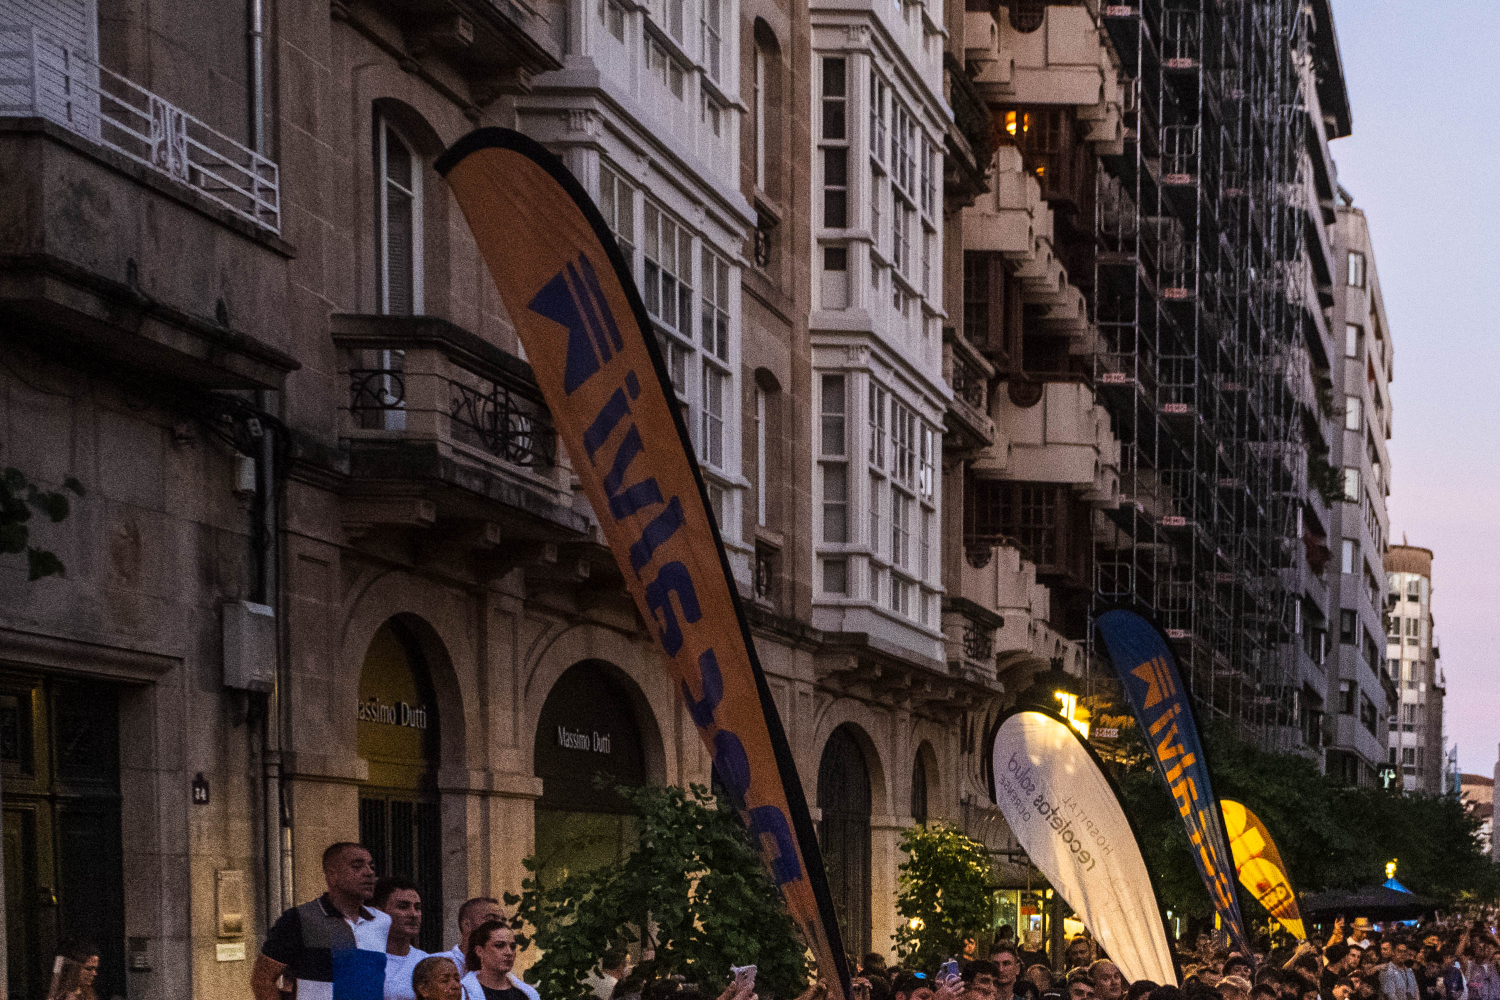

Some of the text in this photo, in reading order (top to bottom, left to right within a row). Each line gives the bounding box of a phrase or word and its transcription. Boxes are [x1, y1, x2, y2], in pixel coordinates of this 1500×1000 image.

[401, 702, 428, 730] Dutti
[558, 725, 612, 754] Massimo Dutti
